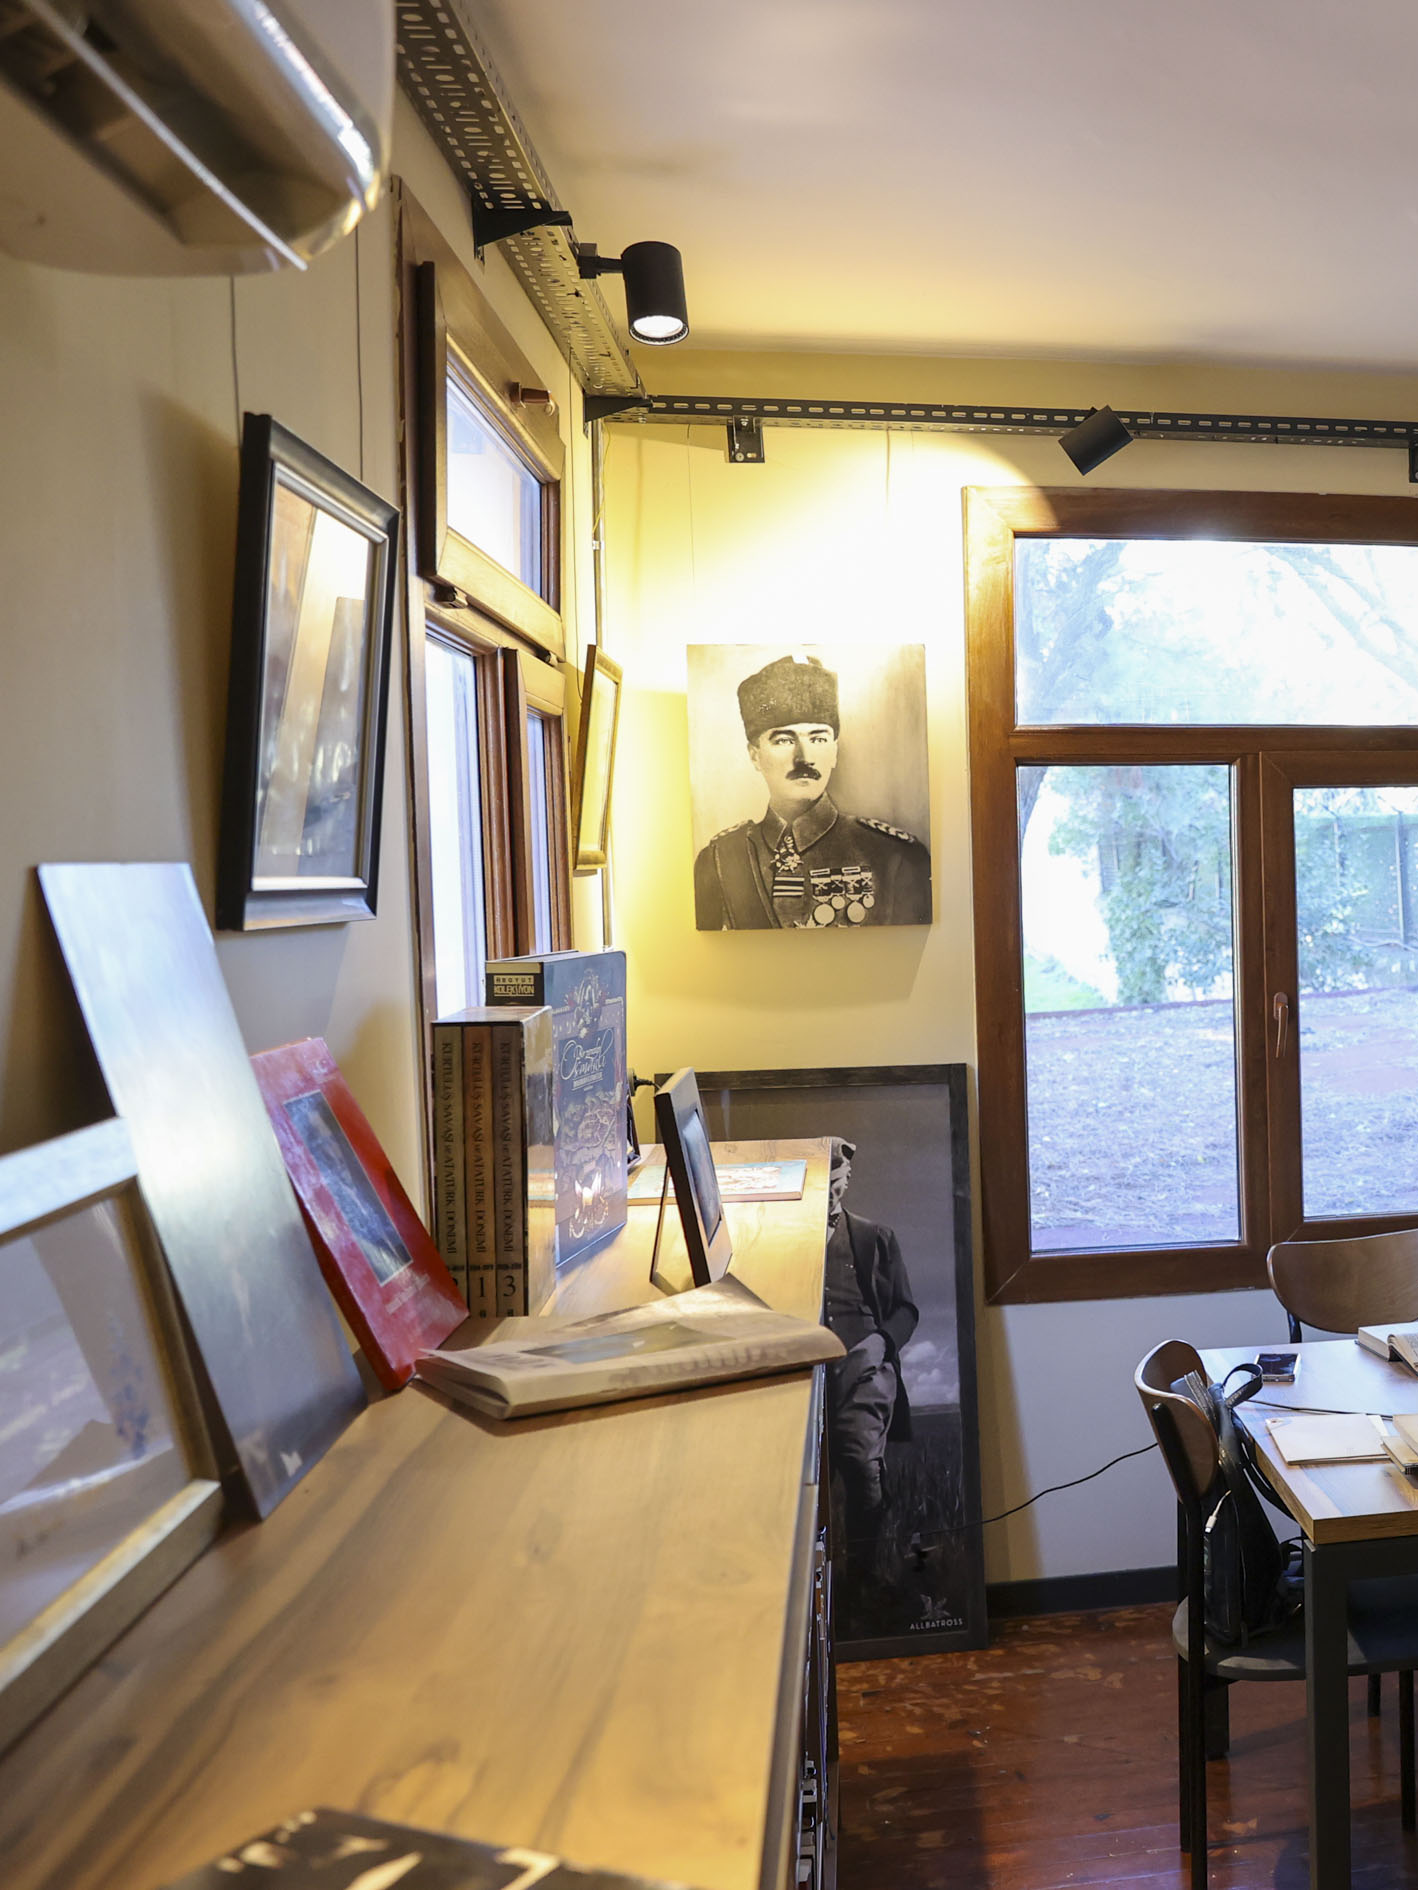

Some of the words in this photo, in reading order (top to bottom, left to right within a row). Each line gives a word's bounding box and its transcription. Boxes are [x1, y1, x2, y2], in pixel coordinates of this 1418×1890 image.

[441, 1104, 455, 1142] SAVAŞI
[470, 1104, 484, 1142] SAVAŞI
[500, 1104, 513, 1141] SAVAŞI
[443, 1157, 457, 1205] ATATÜRK
[474, 1154, 485, 1204] ATATÜRK
[503, 1154, 514, 1204] ATATÜRK
[445, 1210, 458, 1253] DÖNEMİ
[475, 1209, 488, 1252] DÖNEMİ
[503, 1209, 515, 1251] DÖNEMİ
[480, 1277, 485, 1297] 1
[504, 1275, 516, 1297] 3
[910, 1618, 963, 1630] ALLBATROSS
